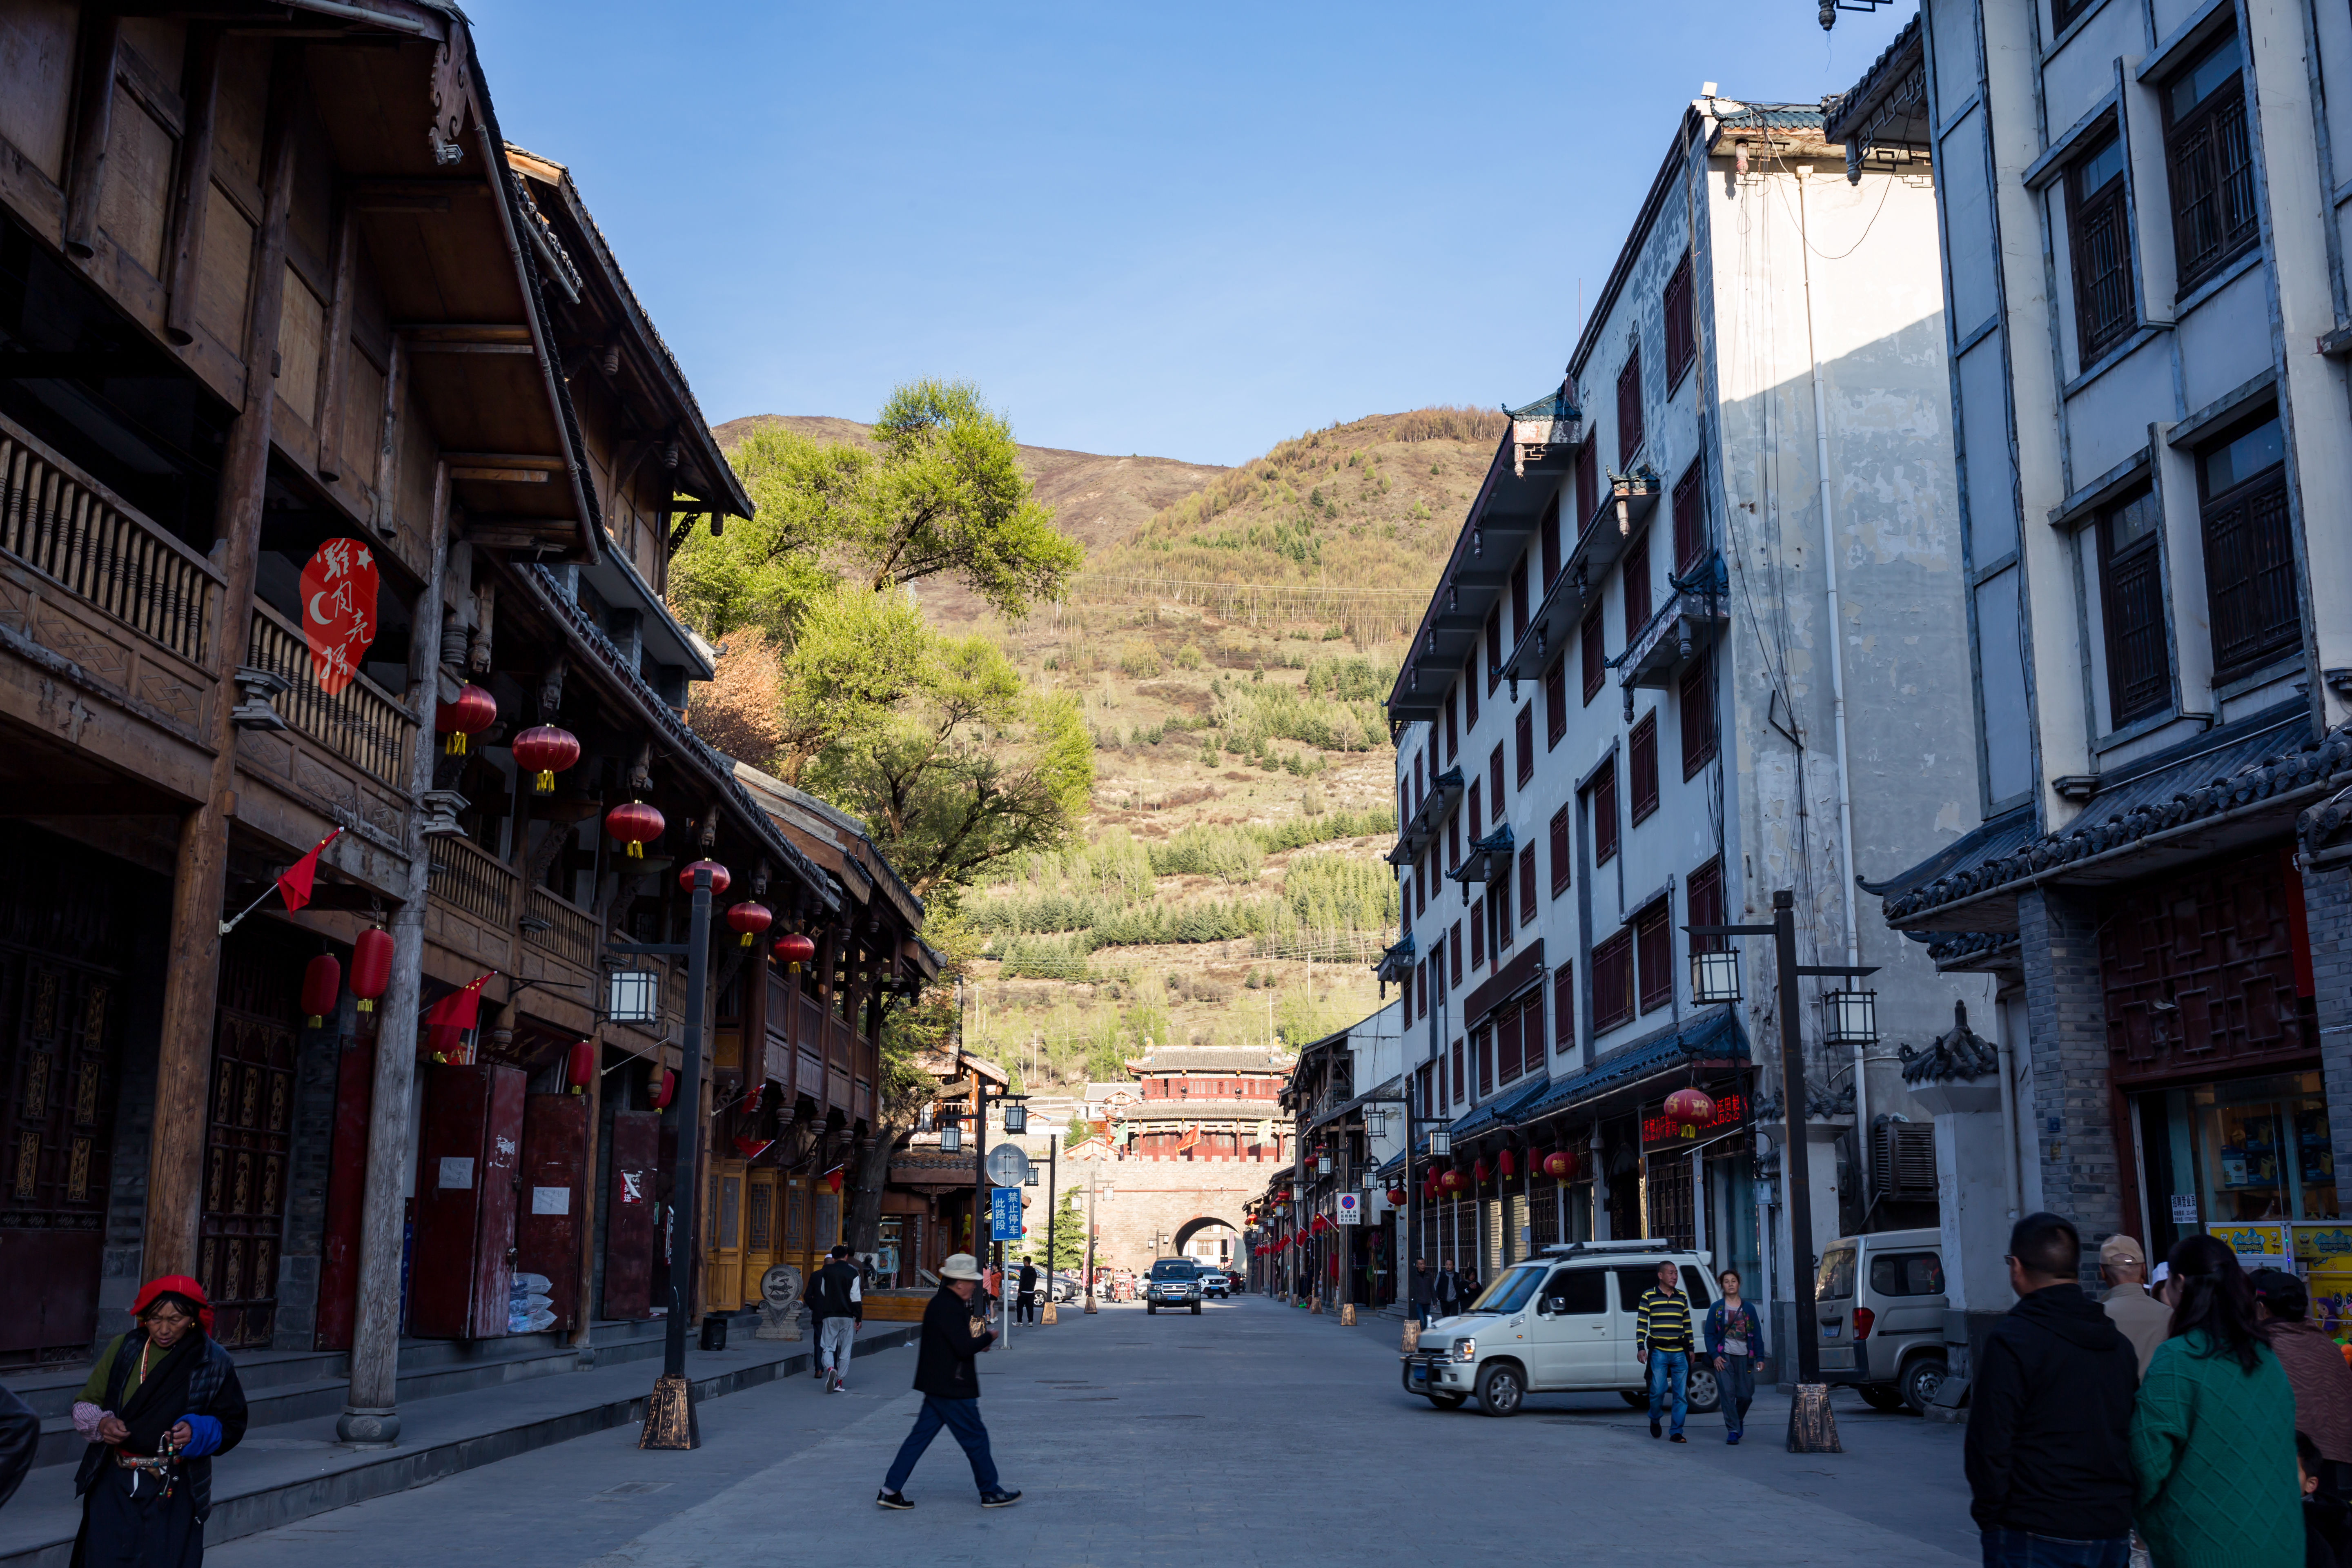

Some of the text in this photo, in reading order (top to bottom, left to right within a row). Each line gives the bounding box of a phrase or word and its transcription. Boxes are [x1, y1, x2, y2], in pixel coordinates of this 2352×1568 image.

[1691, 1099, 1708, 1118] 欢
[1552, 1159, 1566, 1173] 佳
[995, 1198, 1006, 1230] 此路段
[1008, 1192, 1019, 1235] 禁止停车
